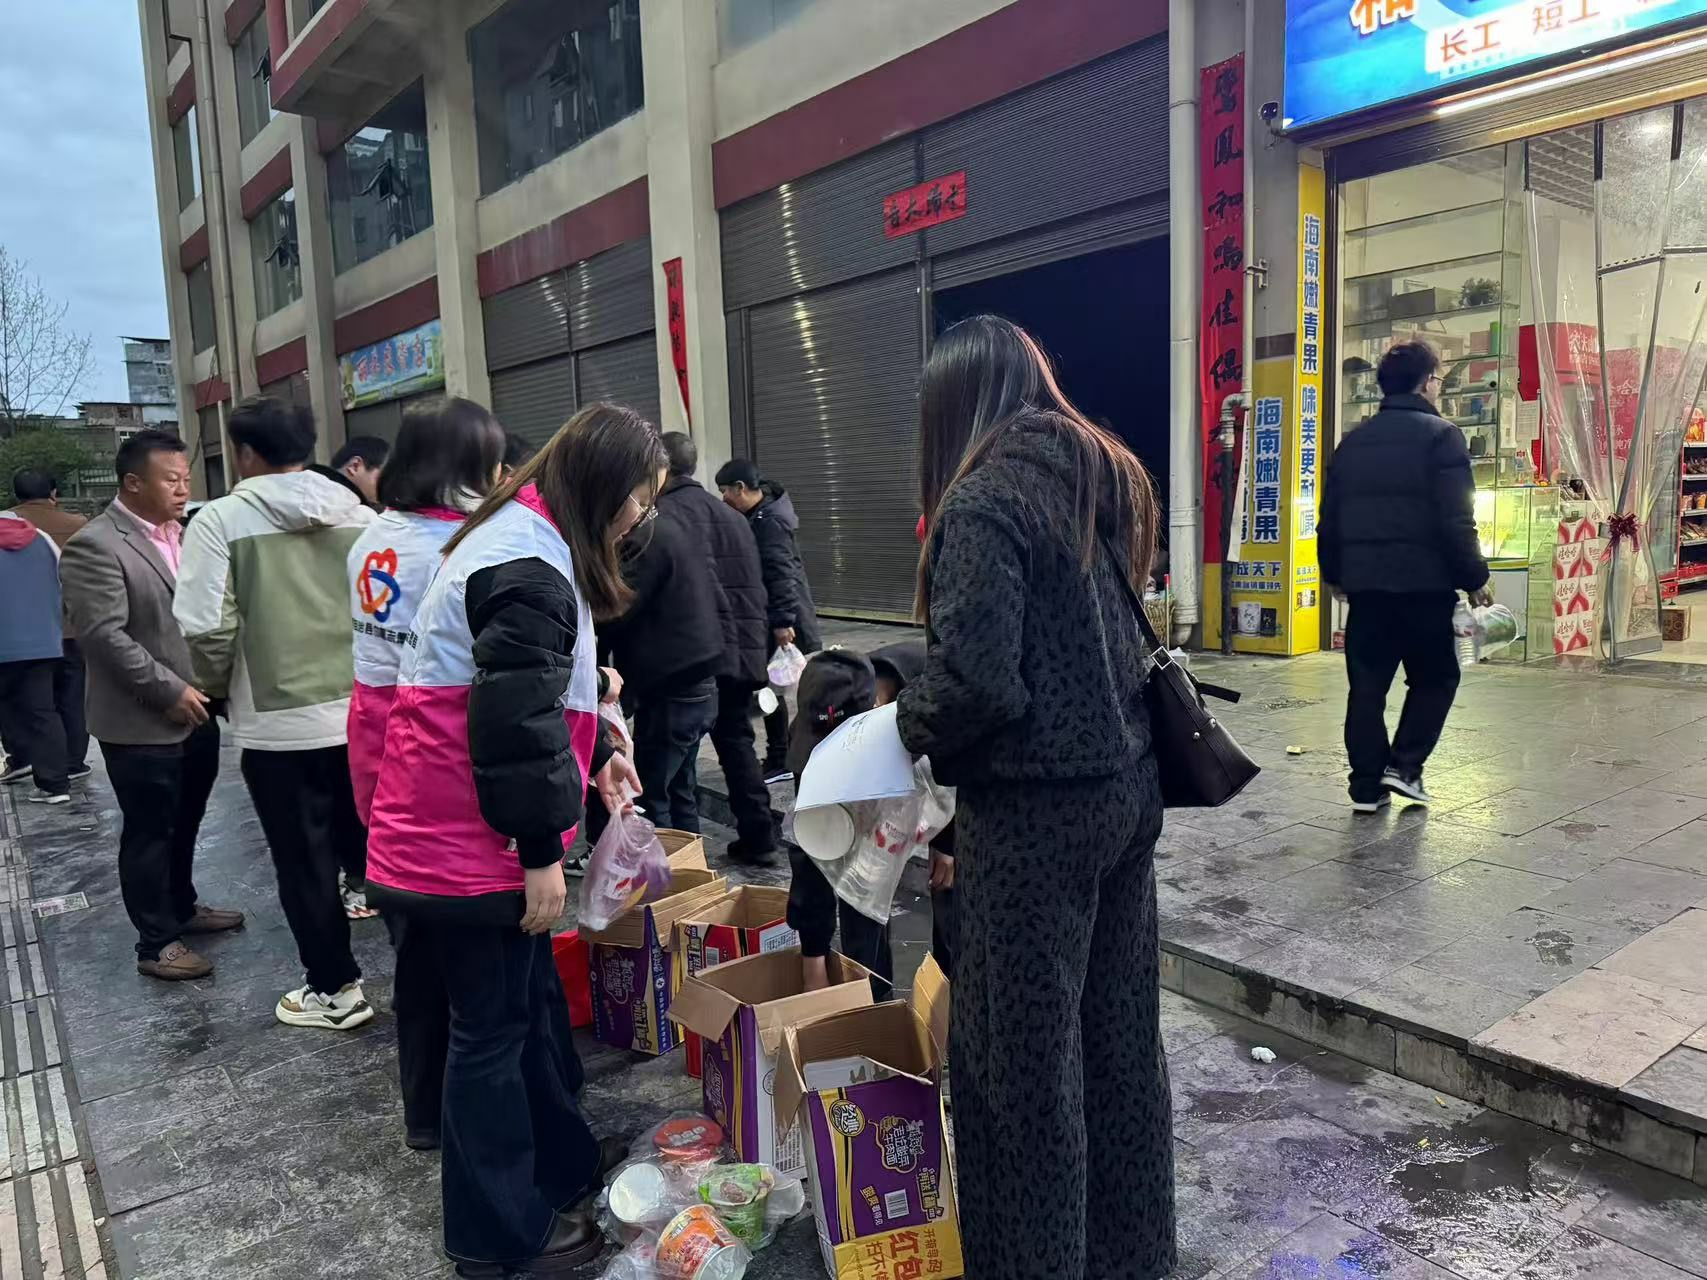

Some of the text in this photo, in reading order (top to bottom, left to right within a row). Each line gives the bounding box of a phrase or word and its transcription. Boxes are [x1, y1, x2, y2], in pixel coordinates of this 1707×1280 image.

[1438, 20, 1500, 63] 长工
[1532, 0, 1600, 35] 短工
[1304, 215, 1320, 371] 海南嫩青果
[1255, 401, 1281, 541] 海南嫩青果
[1236, 561, 1282, 577] 成天下
[889, 1230, 922, 1280] 红包
